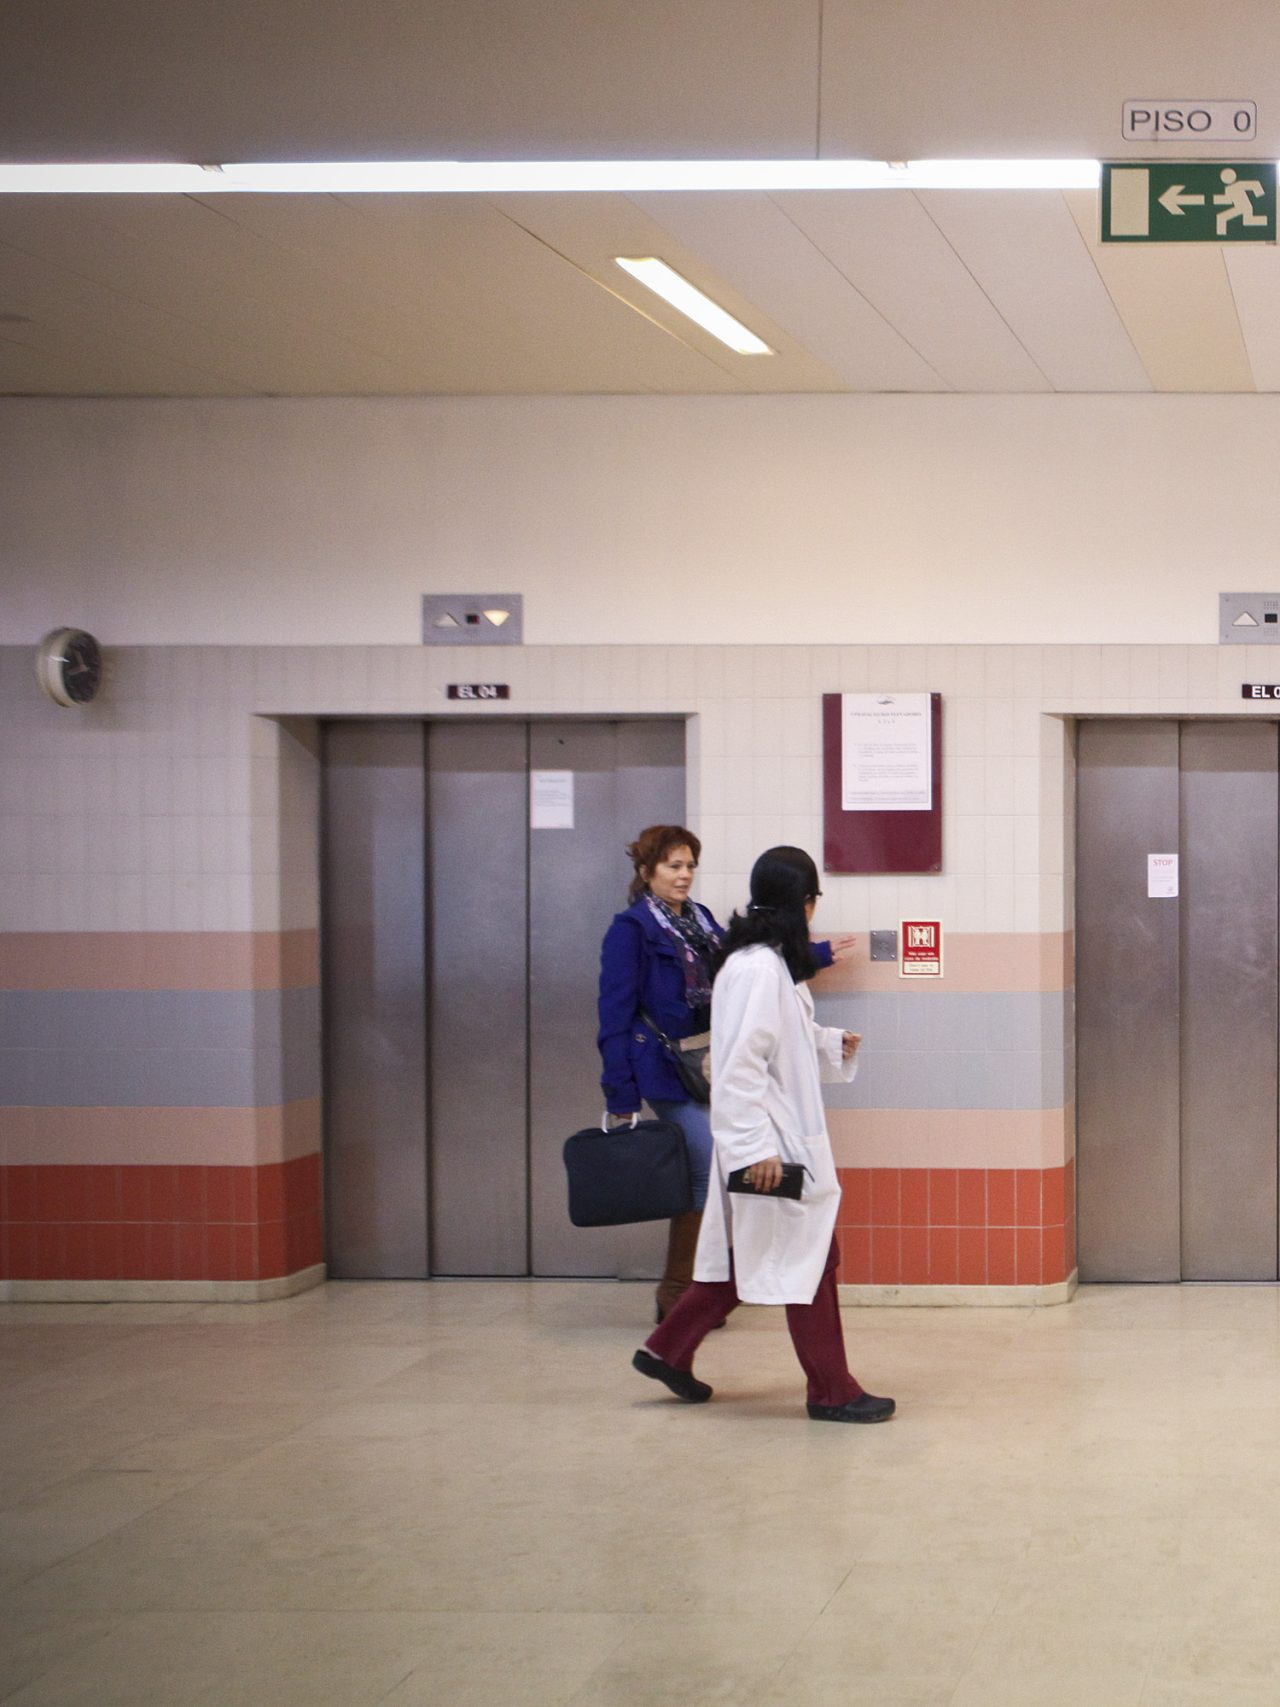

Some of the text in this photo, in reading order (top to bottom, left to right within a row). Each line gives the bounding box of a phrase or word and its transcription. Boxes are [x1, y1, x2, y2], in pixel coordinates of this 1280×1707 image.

[1130, 109, 1212, 132] PISO
[457, 685, 498, 698] EL 04
[1252, 686, 1270, 698] EL
[1152, 858, 1174, 866] STOP
